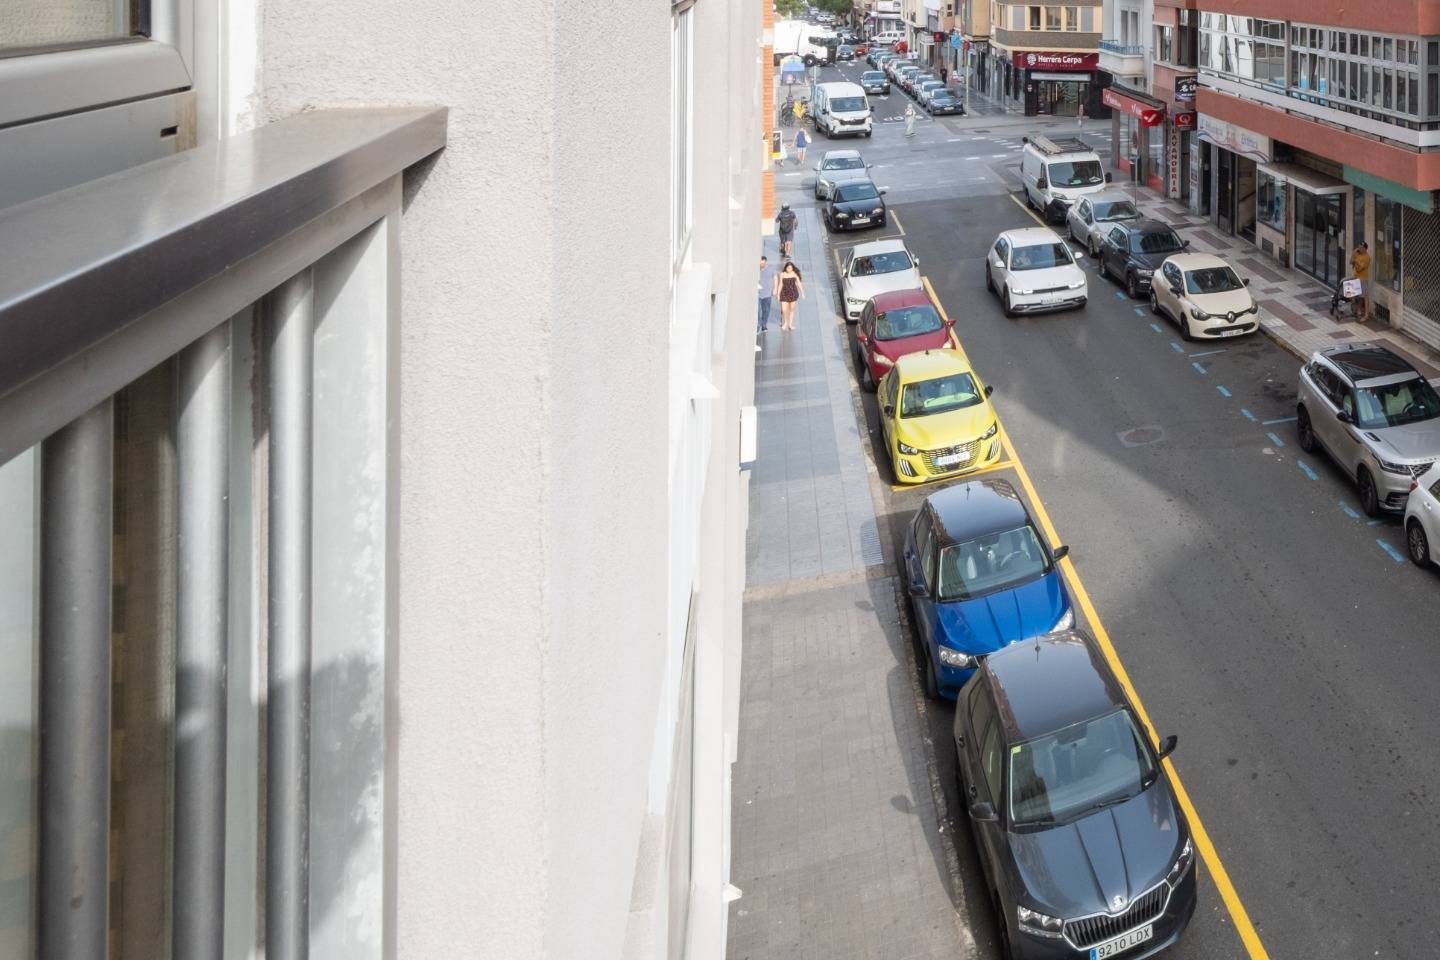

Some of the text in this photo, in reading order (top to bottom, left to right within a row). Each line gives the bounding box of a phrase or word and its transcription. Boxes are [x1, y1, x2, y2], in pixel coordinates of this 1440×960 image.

[1038, 55, 1082, 64] Herrera Cerpa
[1099, 927, 1150, 958] 9210 LDX
